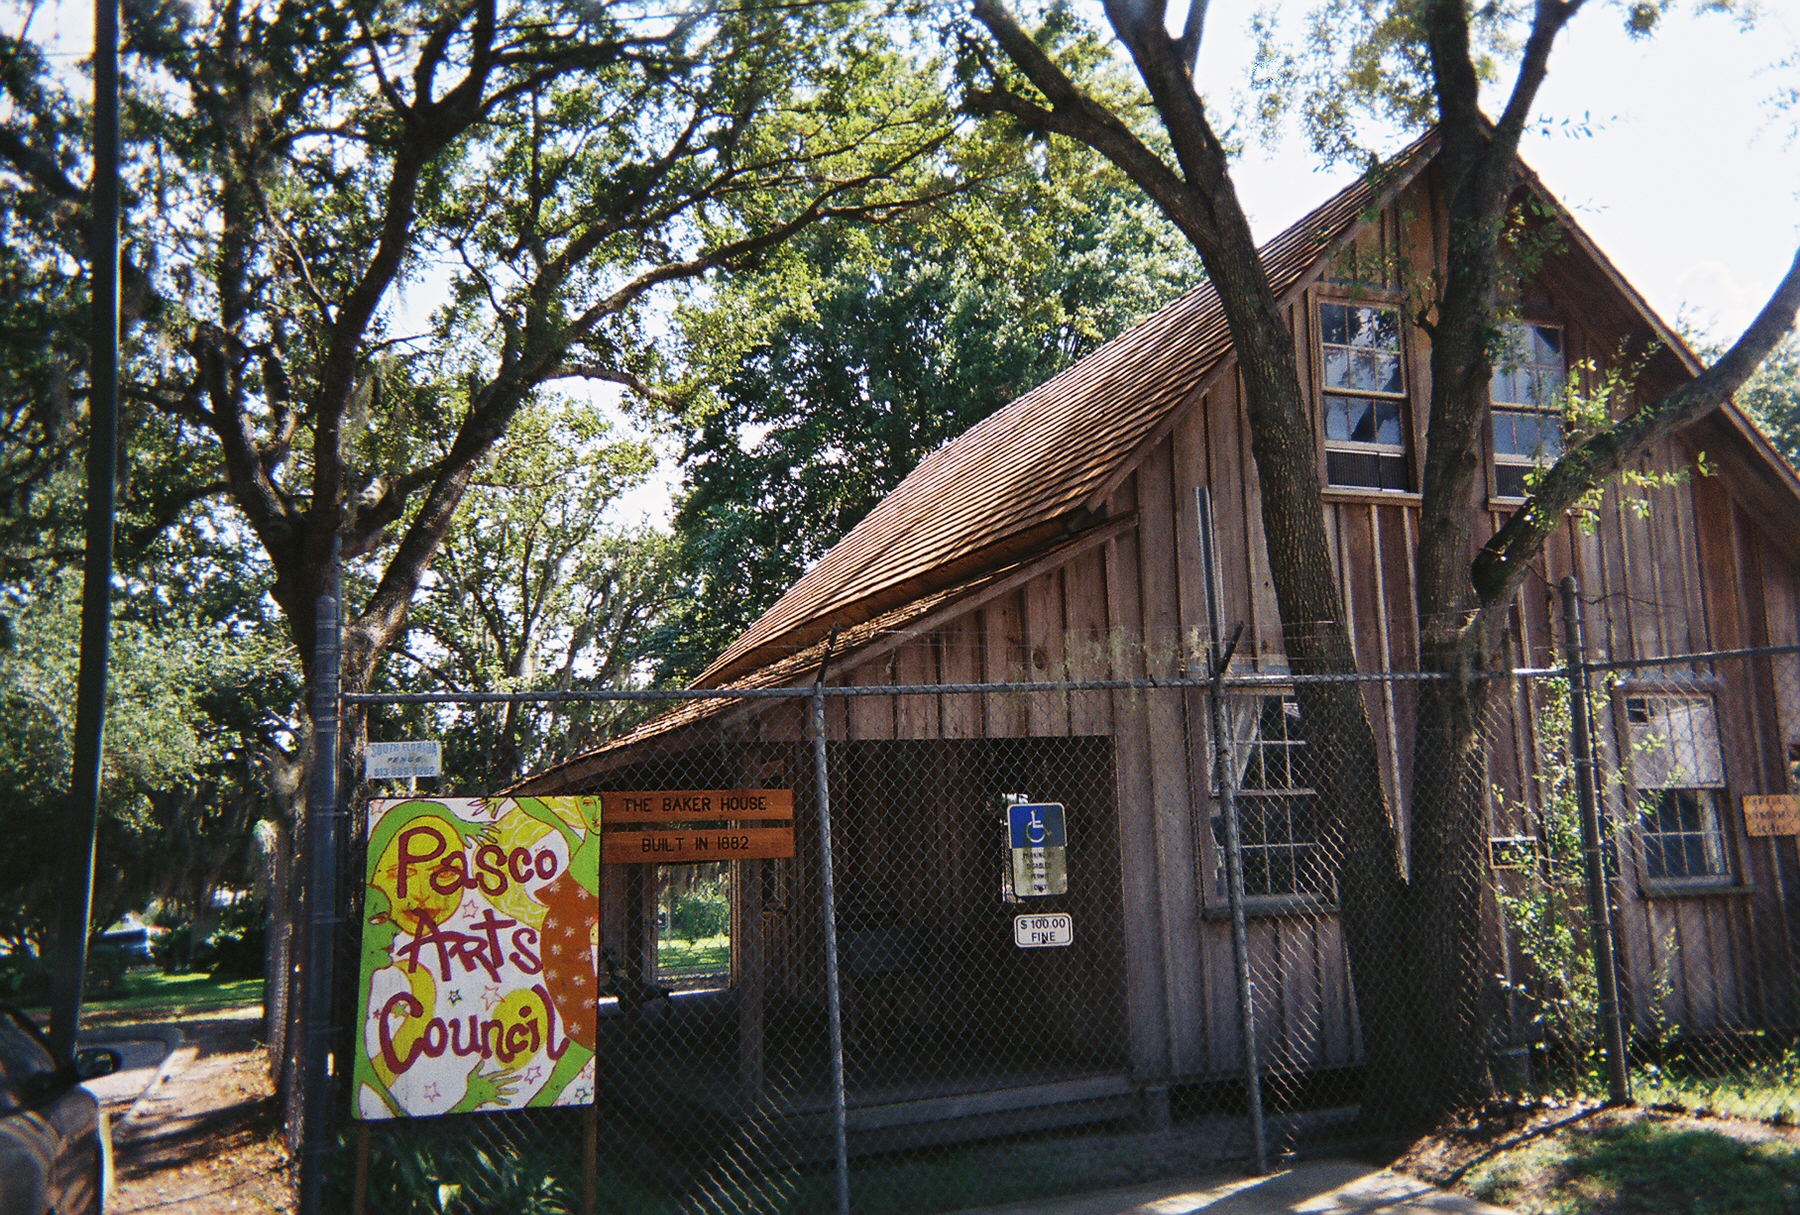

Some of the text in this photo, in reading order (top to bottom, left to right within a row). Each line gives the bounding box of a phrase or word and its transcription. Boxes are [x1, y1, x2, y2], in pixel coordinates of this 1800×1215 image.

[370, 742, 437, 758] SOUTH FLORIDA
[623, 795, 767, 812] THE BAKER HOUSE
[641, 836, 749, 853] BUILT IN 1882
[396, 826, 558, 899] Pasco
[1031, 931, 1056, 942] FINE
[379, 984, 570, 1075] Council
